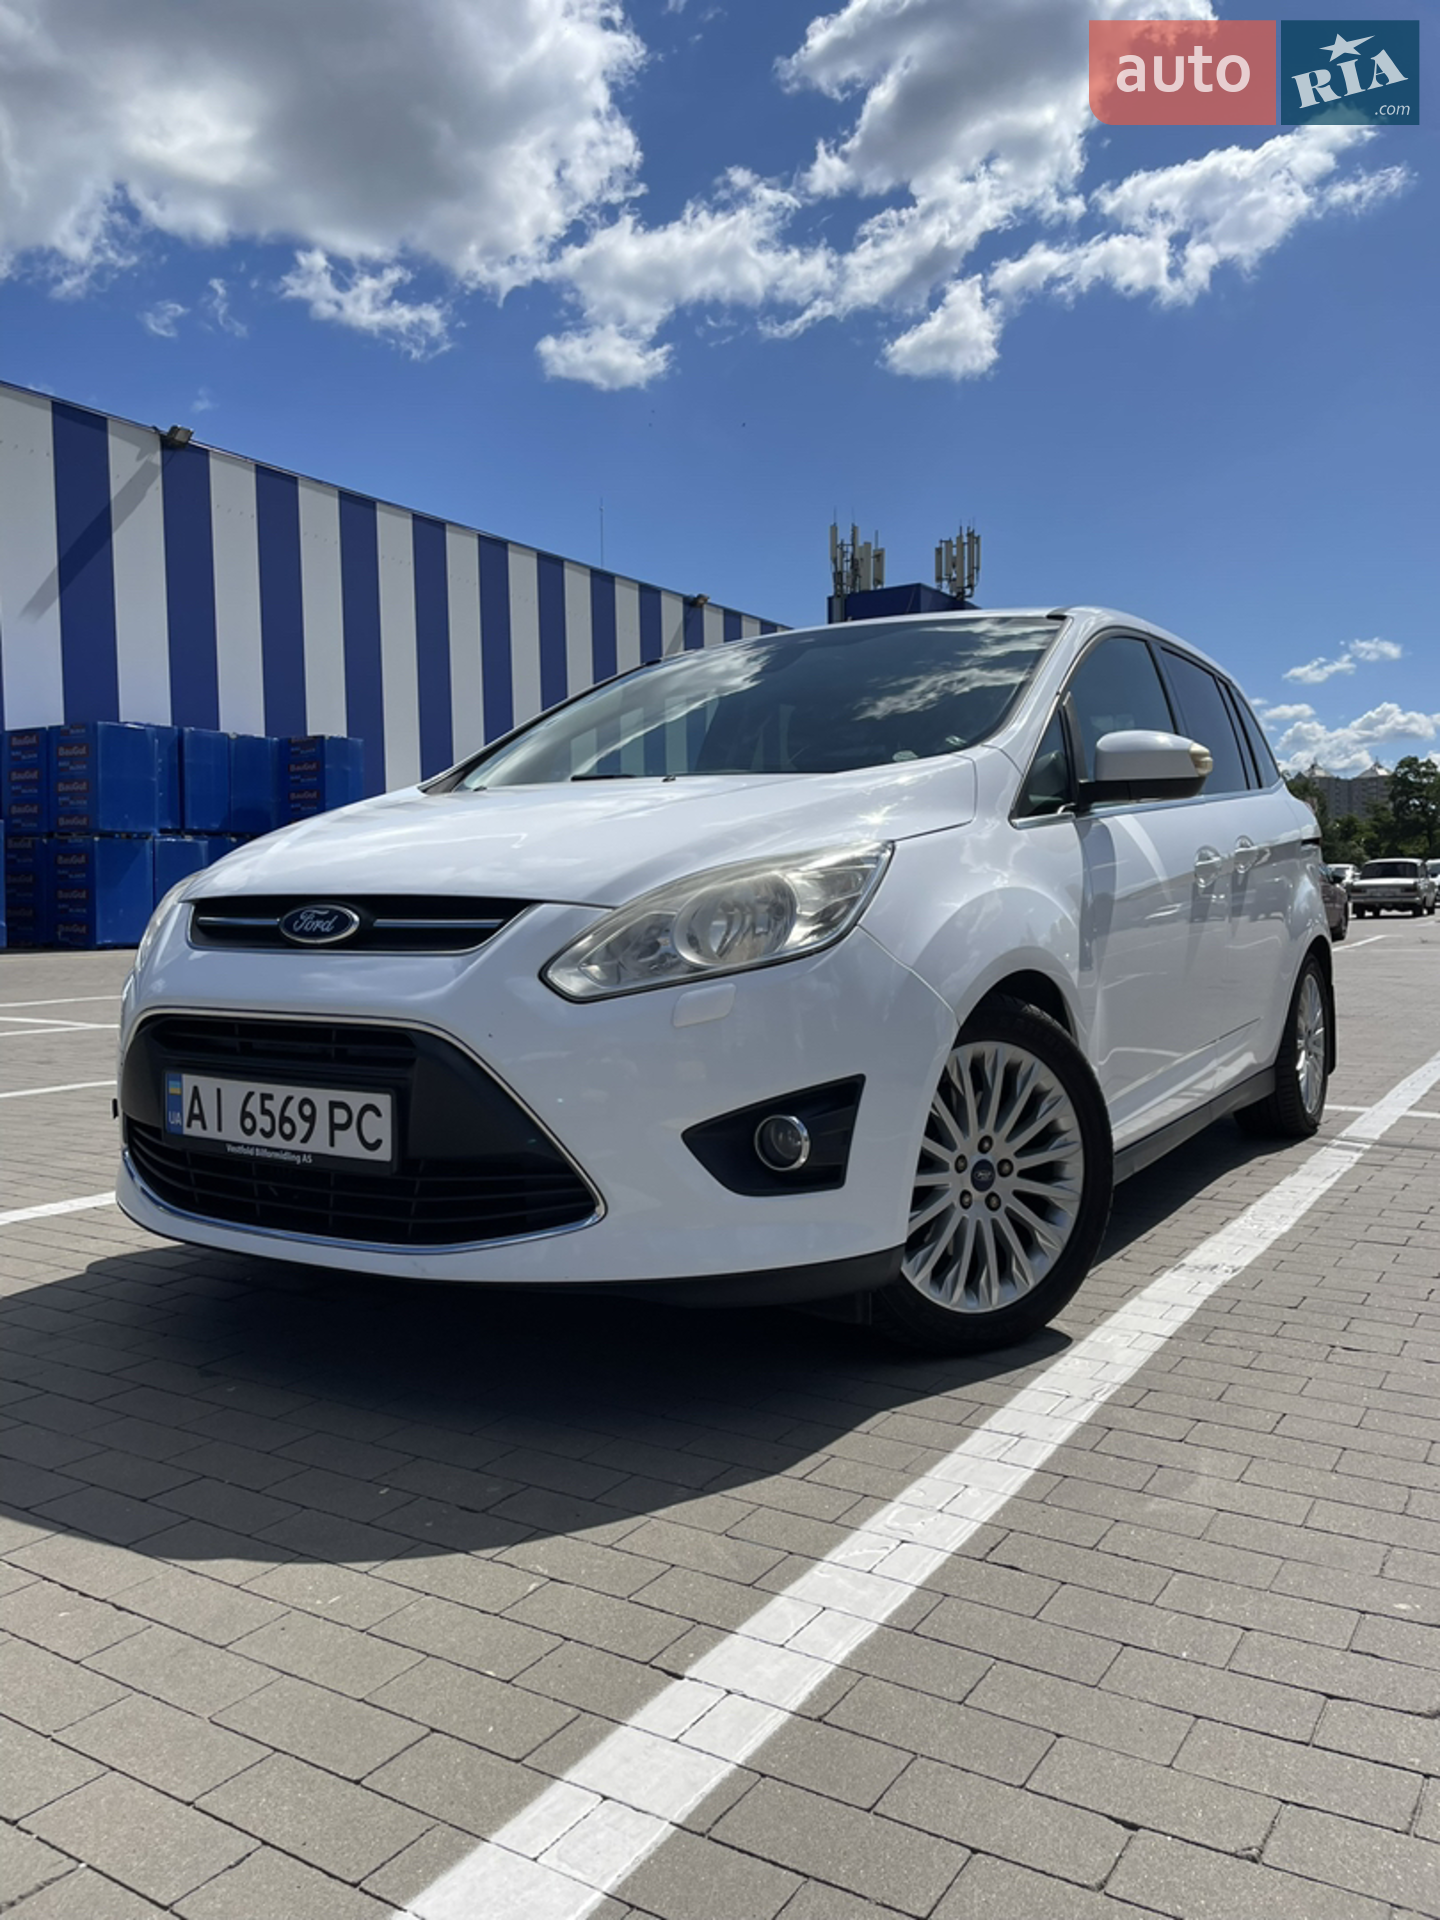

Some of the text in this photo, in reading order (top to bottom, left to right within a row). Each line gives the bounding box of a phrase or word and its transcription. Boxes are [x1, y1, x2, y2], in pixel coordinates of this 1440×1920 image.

[293, 909, 339, 933] Ford
[168, 1110, 182, 1126] UA
[186, 1085, 383, 1152] AI 6569 PC
[302, 1153, 313, 1164] AS
